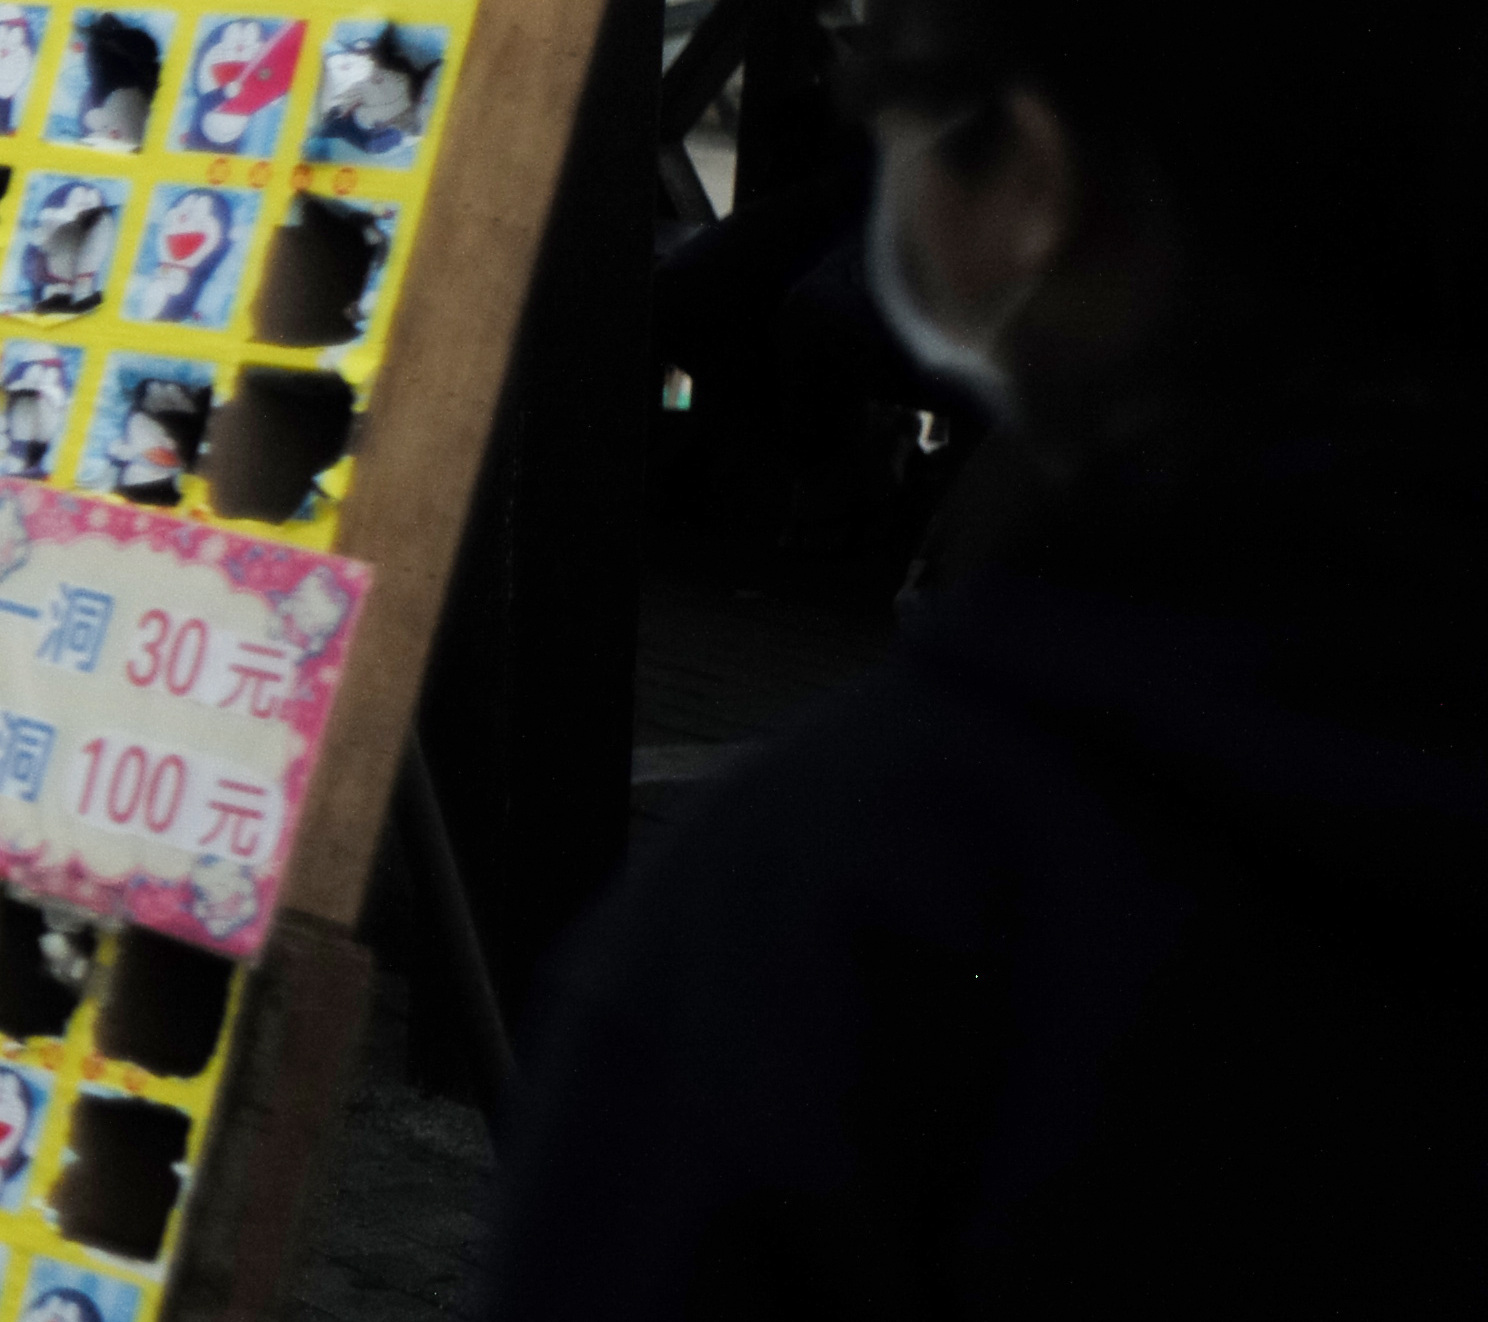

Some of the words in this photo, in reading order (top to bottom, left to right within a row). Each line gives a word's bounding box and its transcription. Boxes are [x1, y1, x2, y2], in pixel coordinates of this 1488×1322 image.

[127, 609, 210, 696] 30
[219, 642, 287, 719] 元
[78, 737, 187, 833] 100
[199, 778, 266, 857] 元
